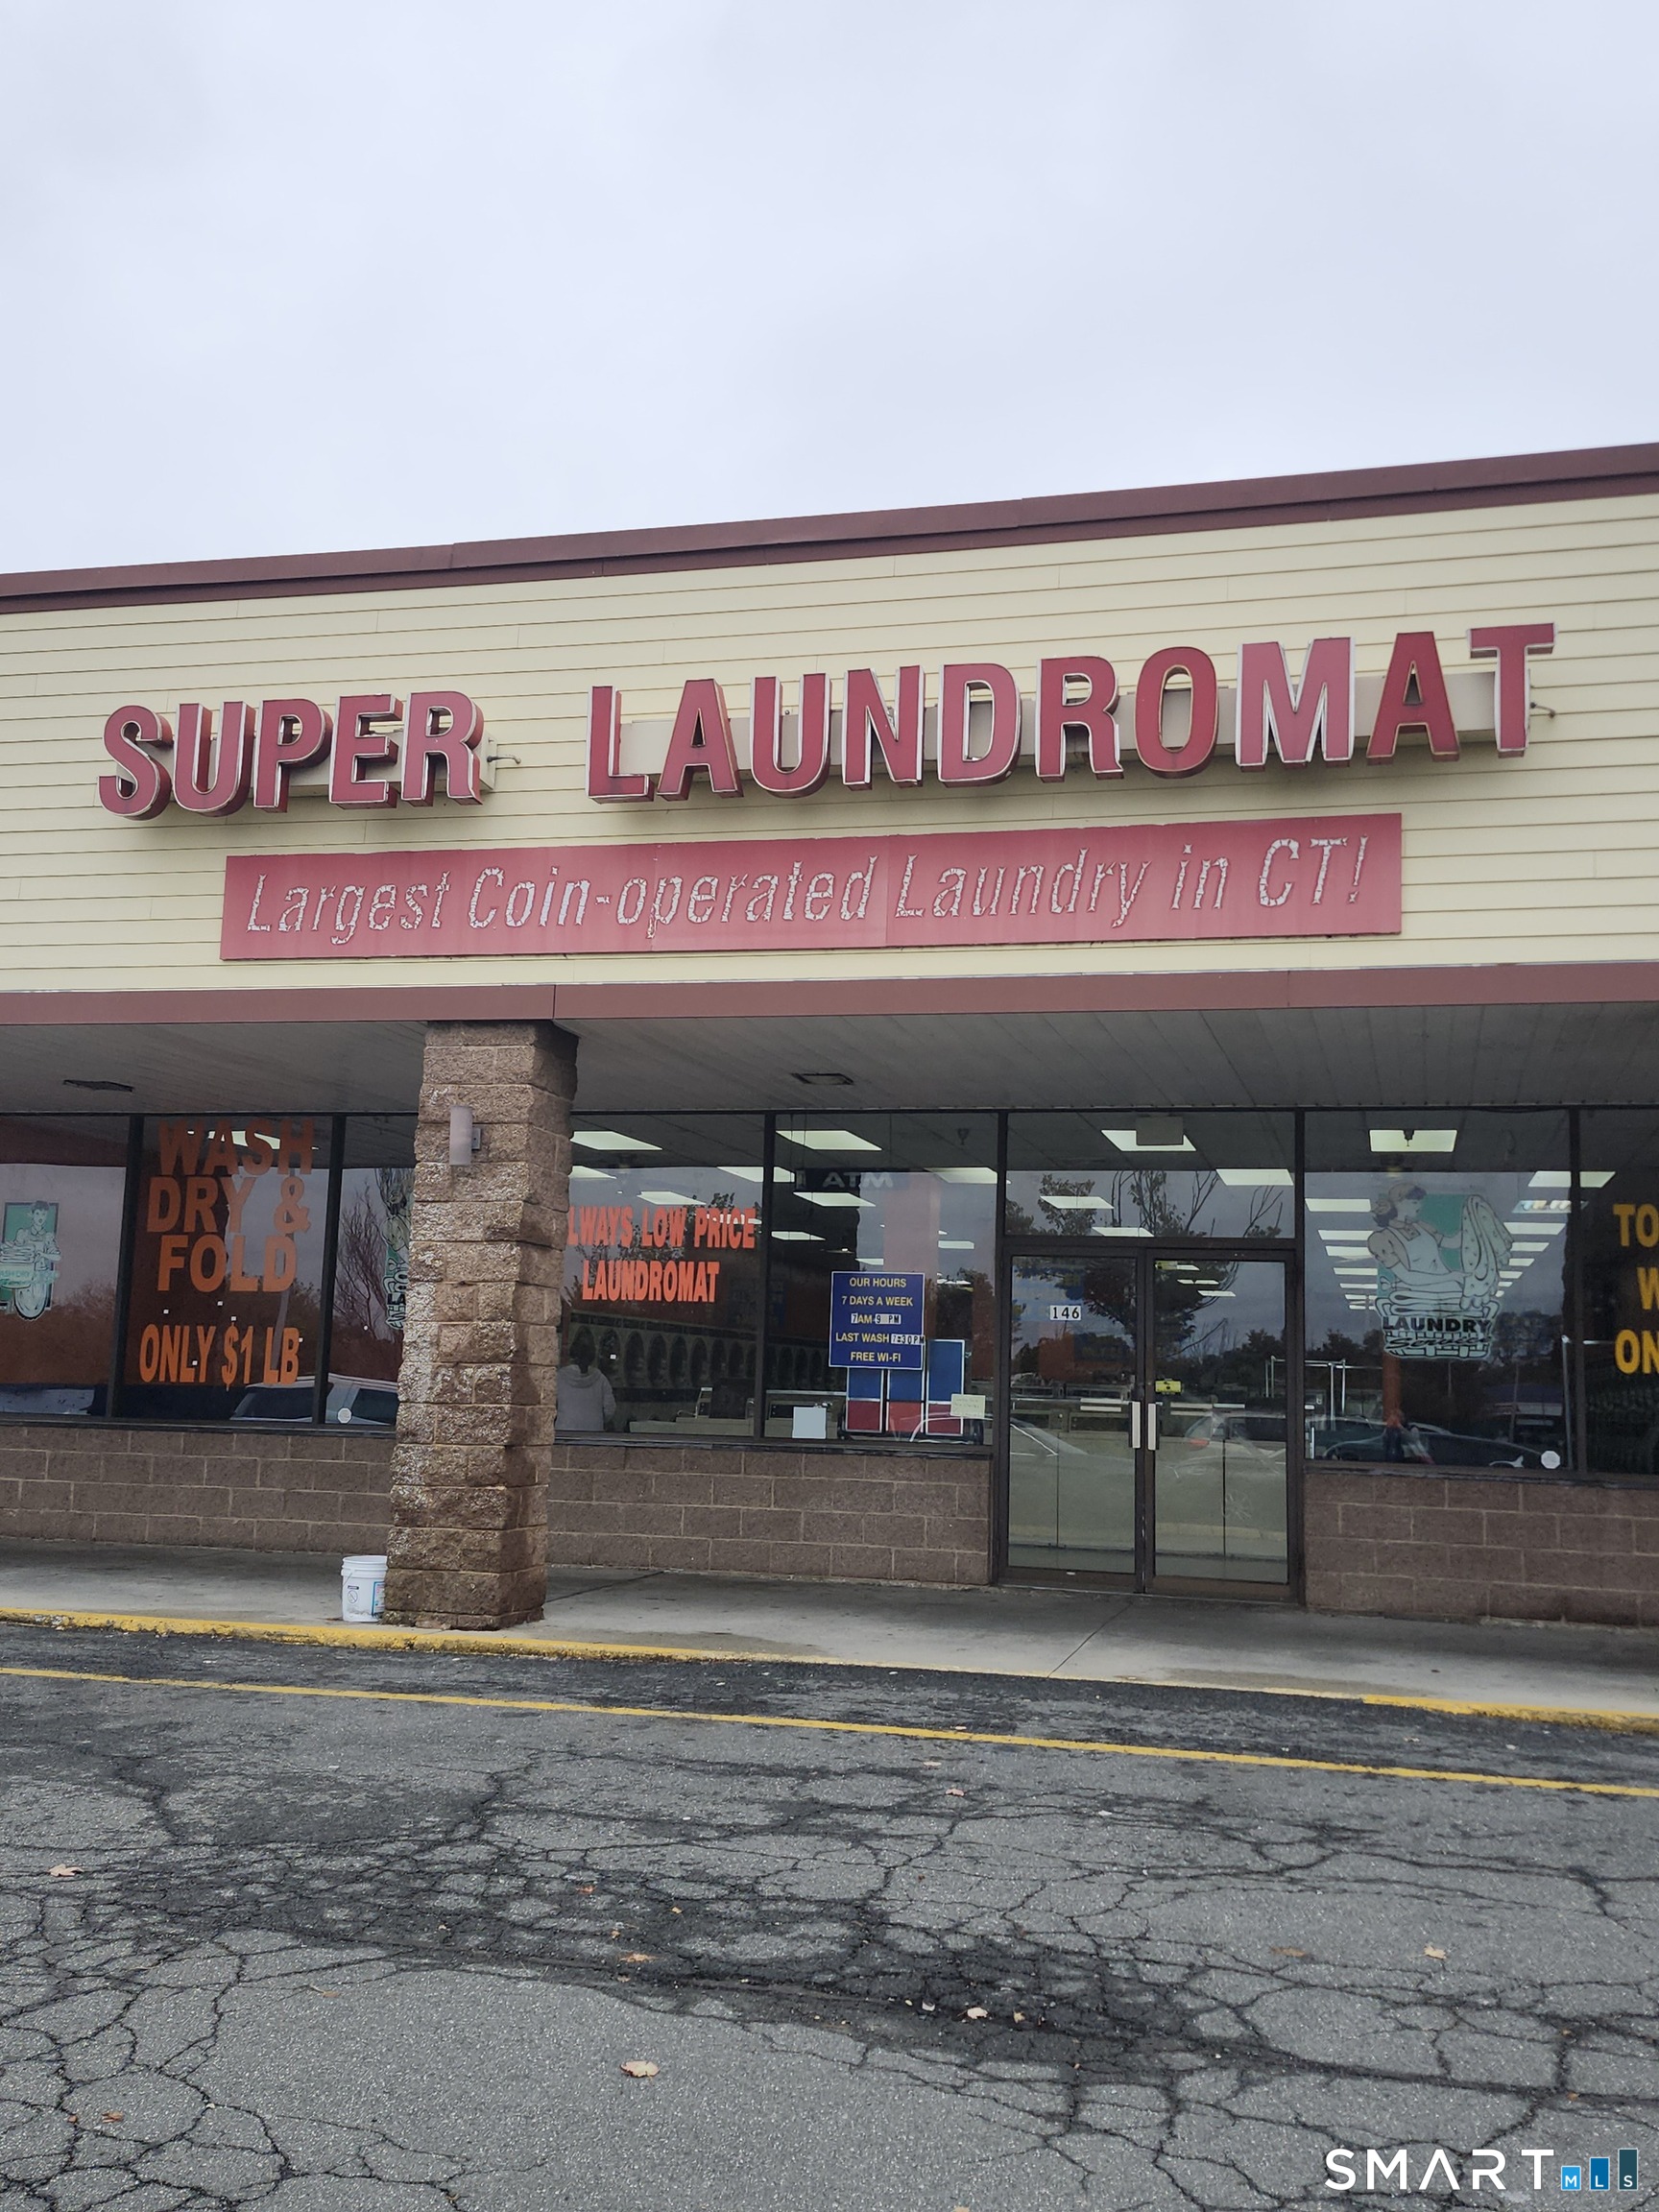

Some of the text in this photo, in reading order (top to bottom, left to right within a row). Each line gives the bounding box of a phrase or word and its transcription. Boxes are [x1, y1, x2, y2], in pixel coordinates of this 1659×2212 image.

[99, 622, 1556, 821] SUPER LAUNDROMAT
[246, 833, 1370, 946] Largest Coin-operated Laundry in CT!
[157, 1117, 315, 1176] WASH
[822, 1171, 894, 1188] ATM
[147, 1175, 312, 1234] DRY &
[567, 1205, 757, 1249] LWAYS LOW PRICE
[156, 1234, 298, 1293] FOLD
[582, 1259, 720, 1303] LAUNDROMAT
[850, 1277, 907, 1288] OUR HOURS
[842, 1295, 913, 1307] 7 DAYS A WEEK
[1052, 1307, 1080, 1319] 146
[835, 1332, 859, 1342] LAST
[861, 1333, 890, 1343] WASH
[1382, 1316, 1491, 1333] LAUNDRY
[139, 1322, 300, 1392] ONLY $1 LB
[851, 1351, 902, 1362] FREE WI-FI
